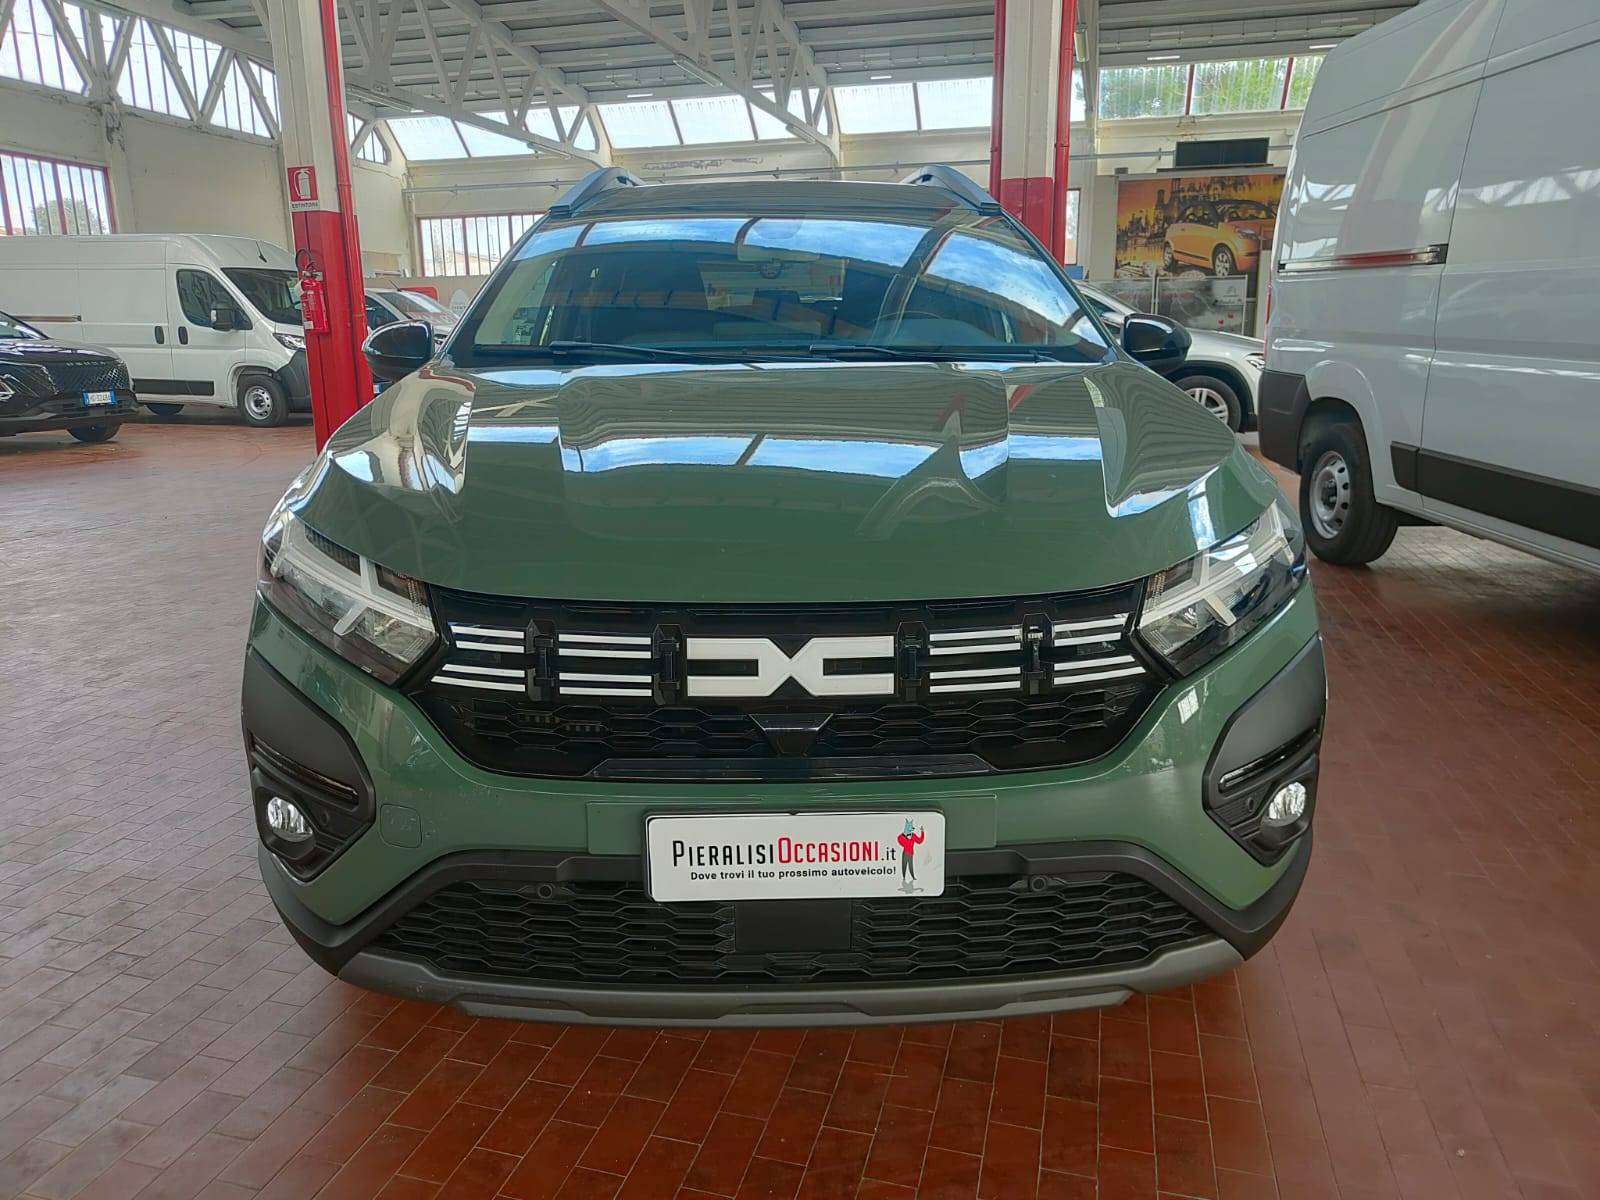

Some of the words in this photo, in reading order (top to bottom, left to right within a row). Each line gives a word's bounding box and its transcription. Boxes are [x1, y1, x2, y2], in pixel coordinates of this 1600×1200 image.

[690, 871, 717, 880] Dove
[720, 870, 745, 880] trovi
[748, 869, 755, 878] il
[758, 870, 775, 878] tuo
[778, 869, 828, 879] prossimo
[831, 866, 897, 876] autoveicolo!
